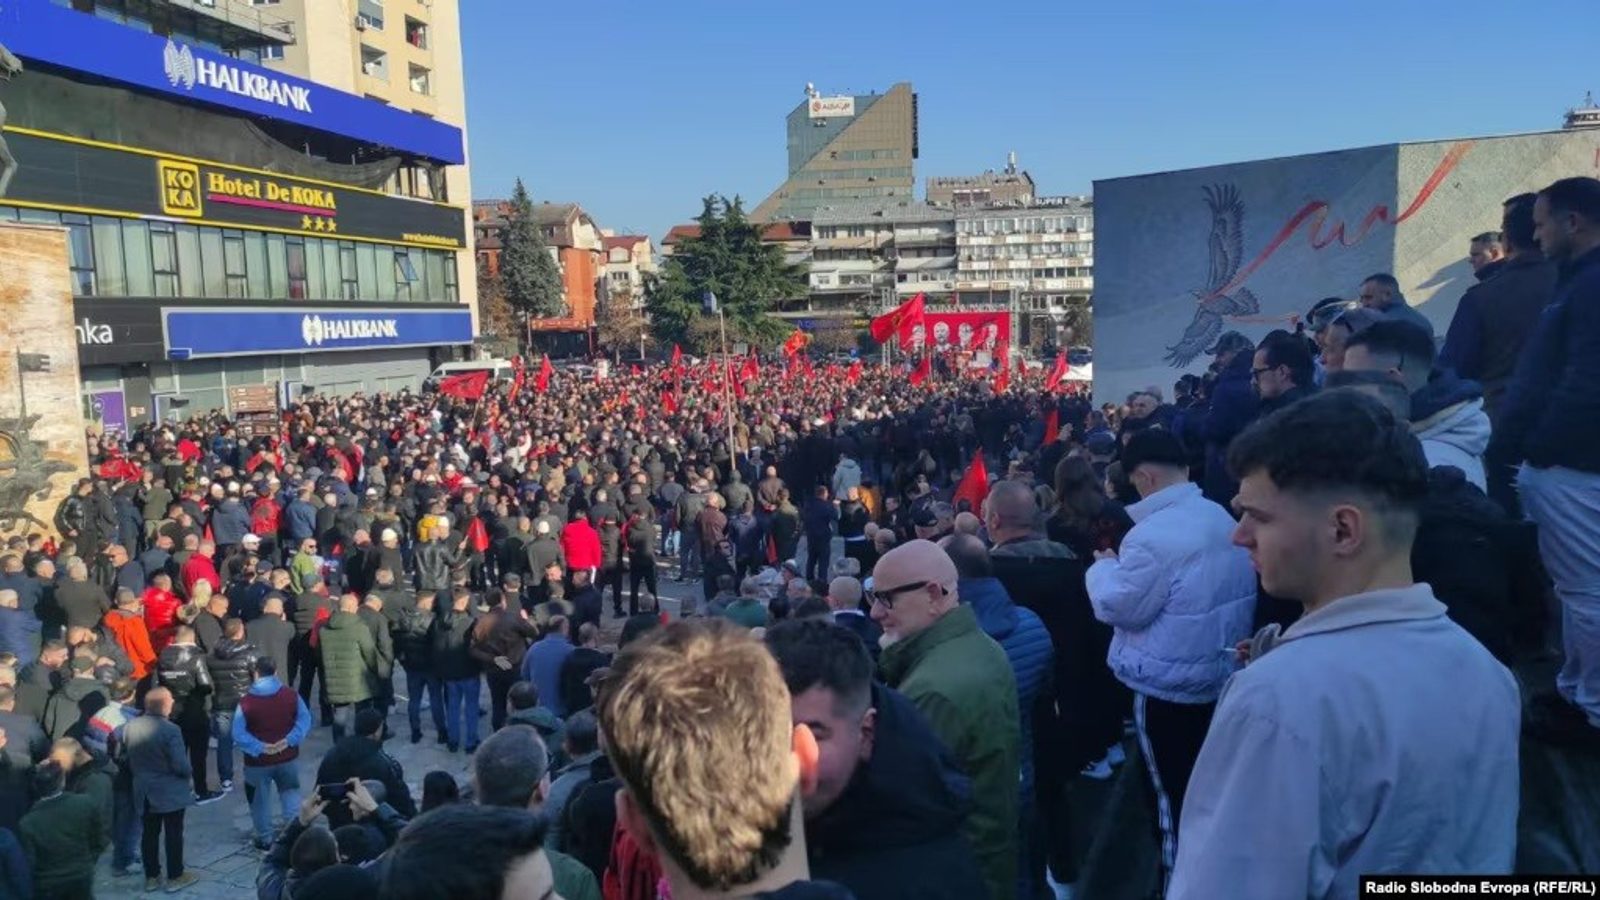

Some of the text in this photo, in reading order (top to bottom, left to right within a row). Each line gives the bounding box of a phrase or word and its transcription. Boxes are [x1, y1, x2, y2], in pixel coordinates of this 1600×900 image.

[196, 57, 313, 113] HALKBANK
[166, 169, 194, 189] KO
[207, 172, 262, 199] Hotel
[168, 188, 196, 208] KA
[74, 317, 113, 344] nka
[322, 319, 398, 339] HALKBANK
